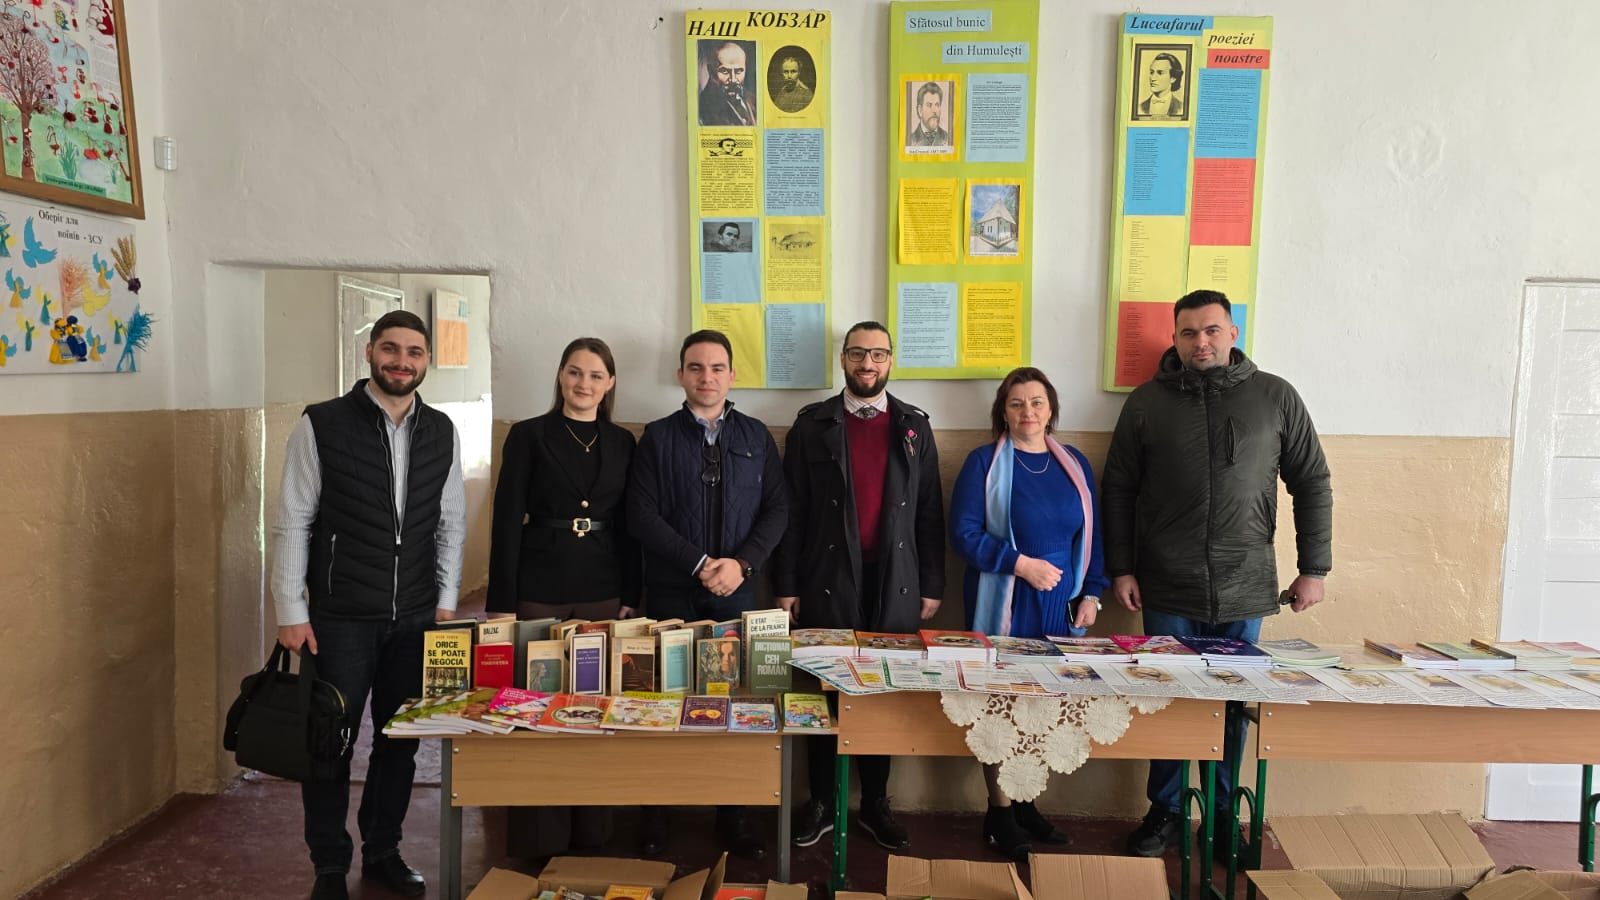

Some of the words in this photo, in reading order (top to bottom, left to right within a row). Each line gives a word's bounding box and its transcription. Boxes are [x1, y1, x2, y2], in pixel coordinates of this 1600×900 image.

[688, 21, 742, 37] НАШ
[746, 12, 826, 28] КОБЗАР
[909, 17, 953, 29] Sfătosul
[956, 17, 986, 28] bunic
[1130, 16, 1205, 33] Luceafarul
[1208, 33, 1255, 47] poeziei
[946, 46, 963, 56] din
[1214, 53, 1263, 64] noastre
[38, 209, 64, 225] Оберіг
[65, 217, 79, 226] для
[57, 230, 80, 241] воїнів
[88, 234, 104, 245] ЗСУ
[435, 641, 459, 649] ORICE
[429, 658, 464, 666] NEGOCIA
